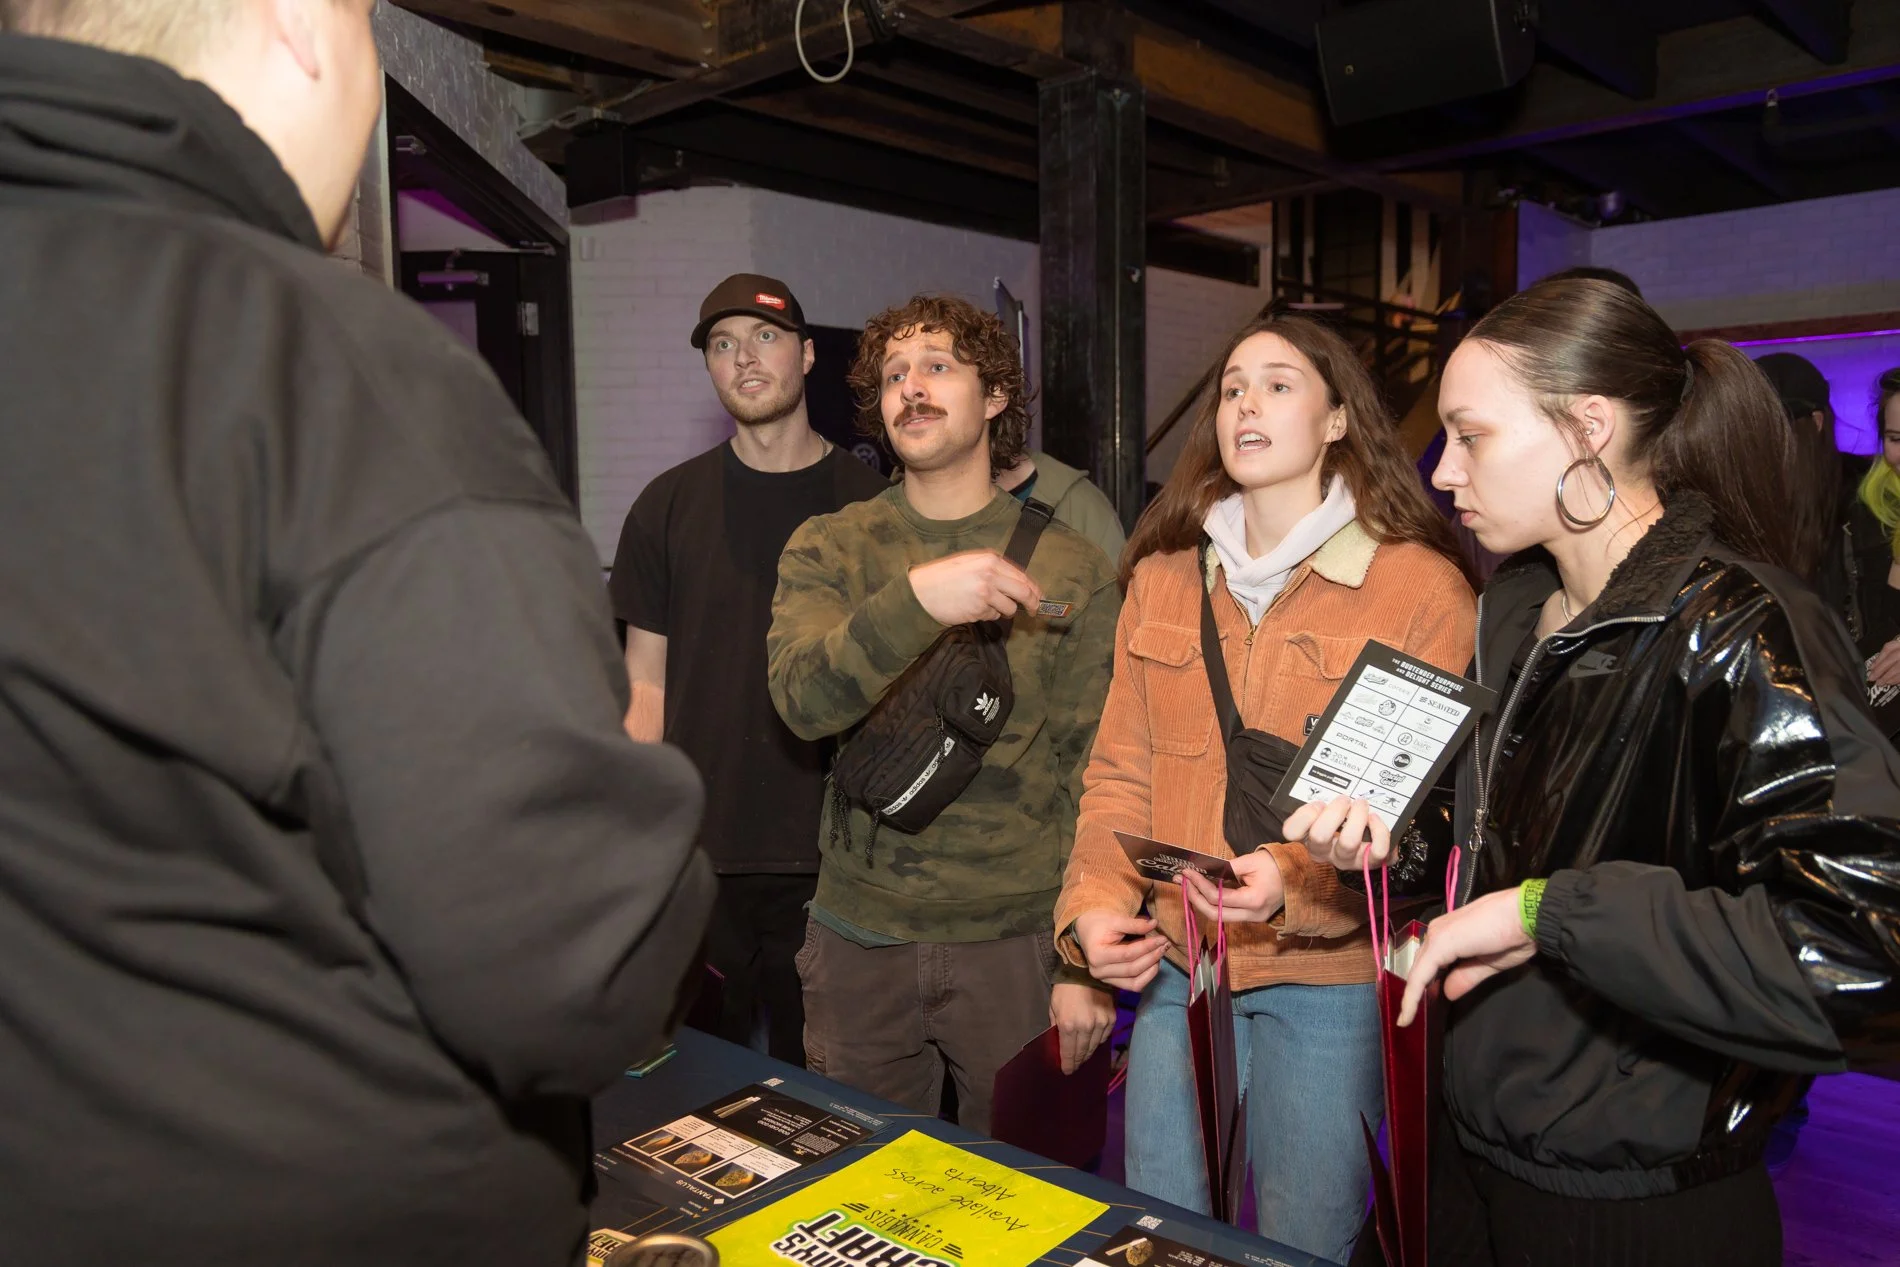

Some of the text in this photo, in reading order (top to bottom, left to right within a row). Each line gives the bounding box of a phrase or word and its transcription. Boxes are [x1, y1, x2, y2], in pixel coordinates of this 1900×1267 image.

[1405, 671, 1430, 686] DELIGHT
[1430, 681, 1453, 695] SERIES
[1435, 675, 1464, 692] SURPRISE
[1427, 699, 1460, 718] SEAWEED
[1336, 732, 1368, 749] PORTAL
[908, 777, 926, 796] adidas
[675, 1179, 713, 1200] TANTALUS
[884, 1168, 945, 1195] across
[944, 1168, 1017, 1201] Alberta
[864, 1209, 943, 1249] CANNABIS
